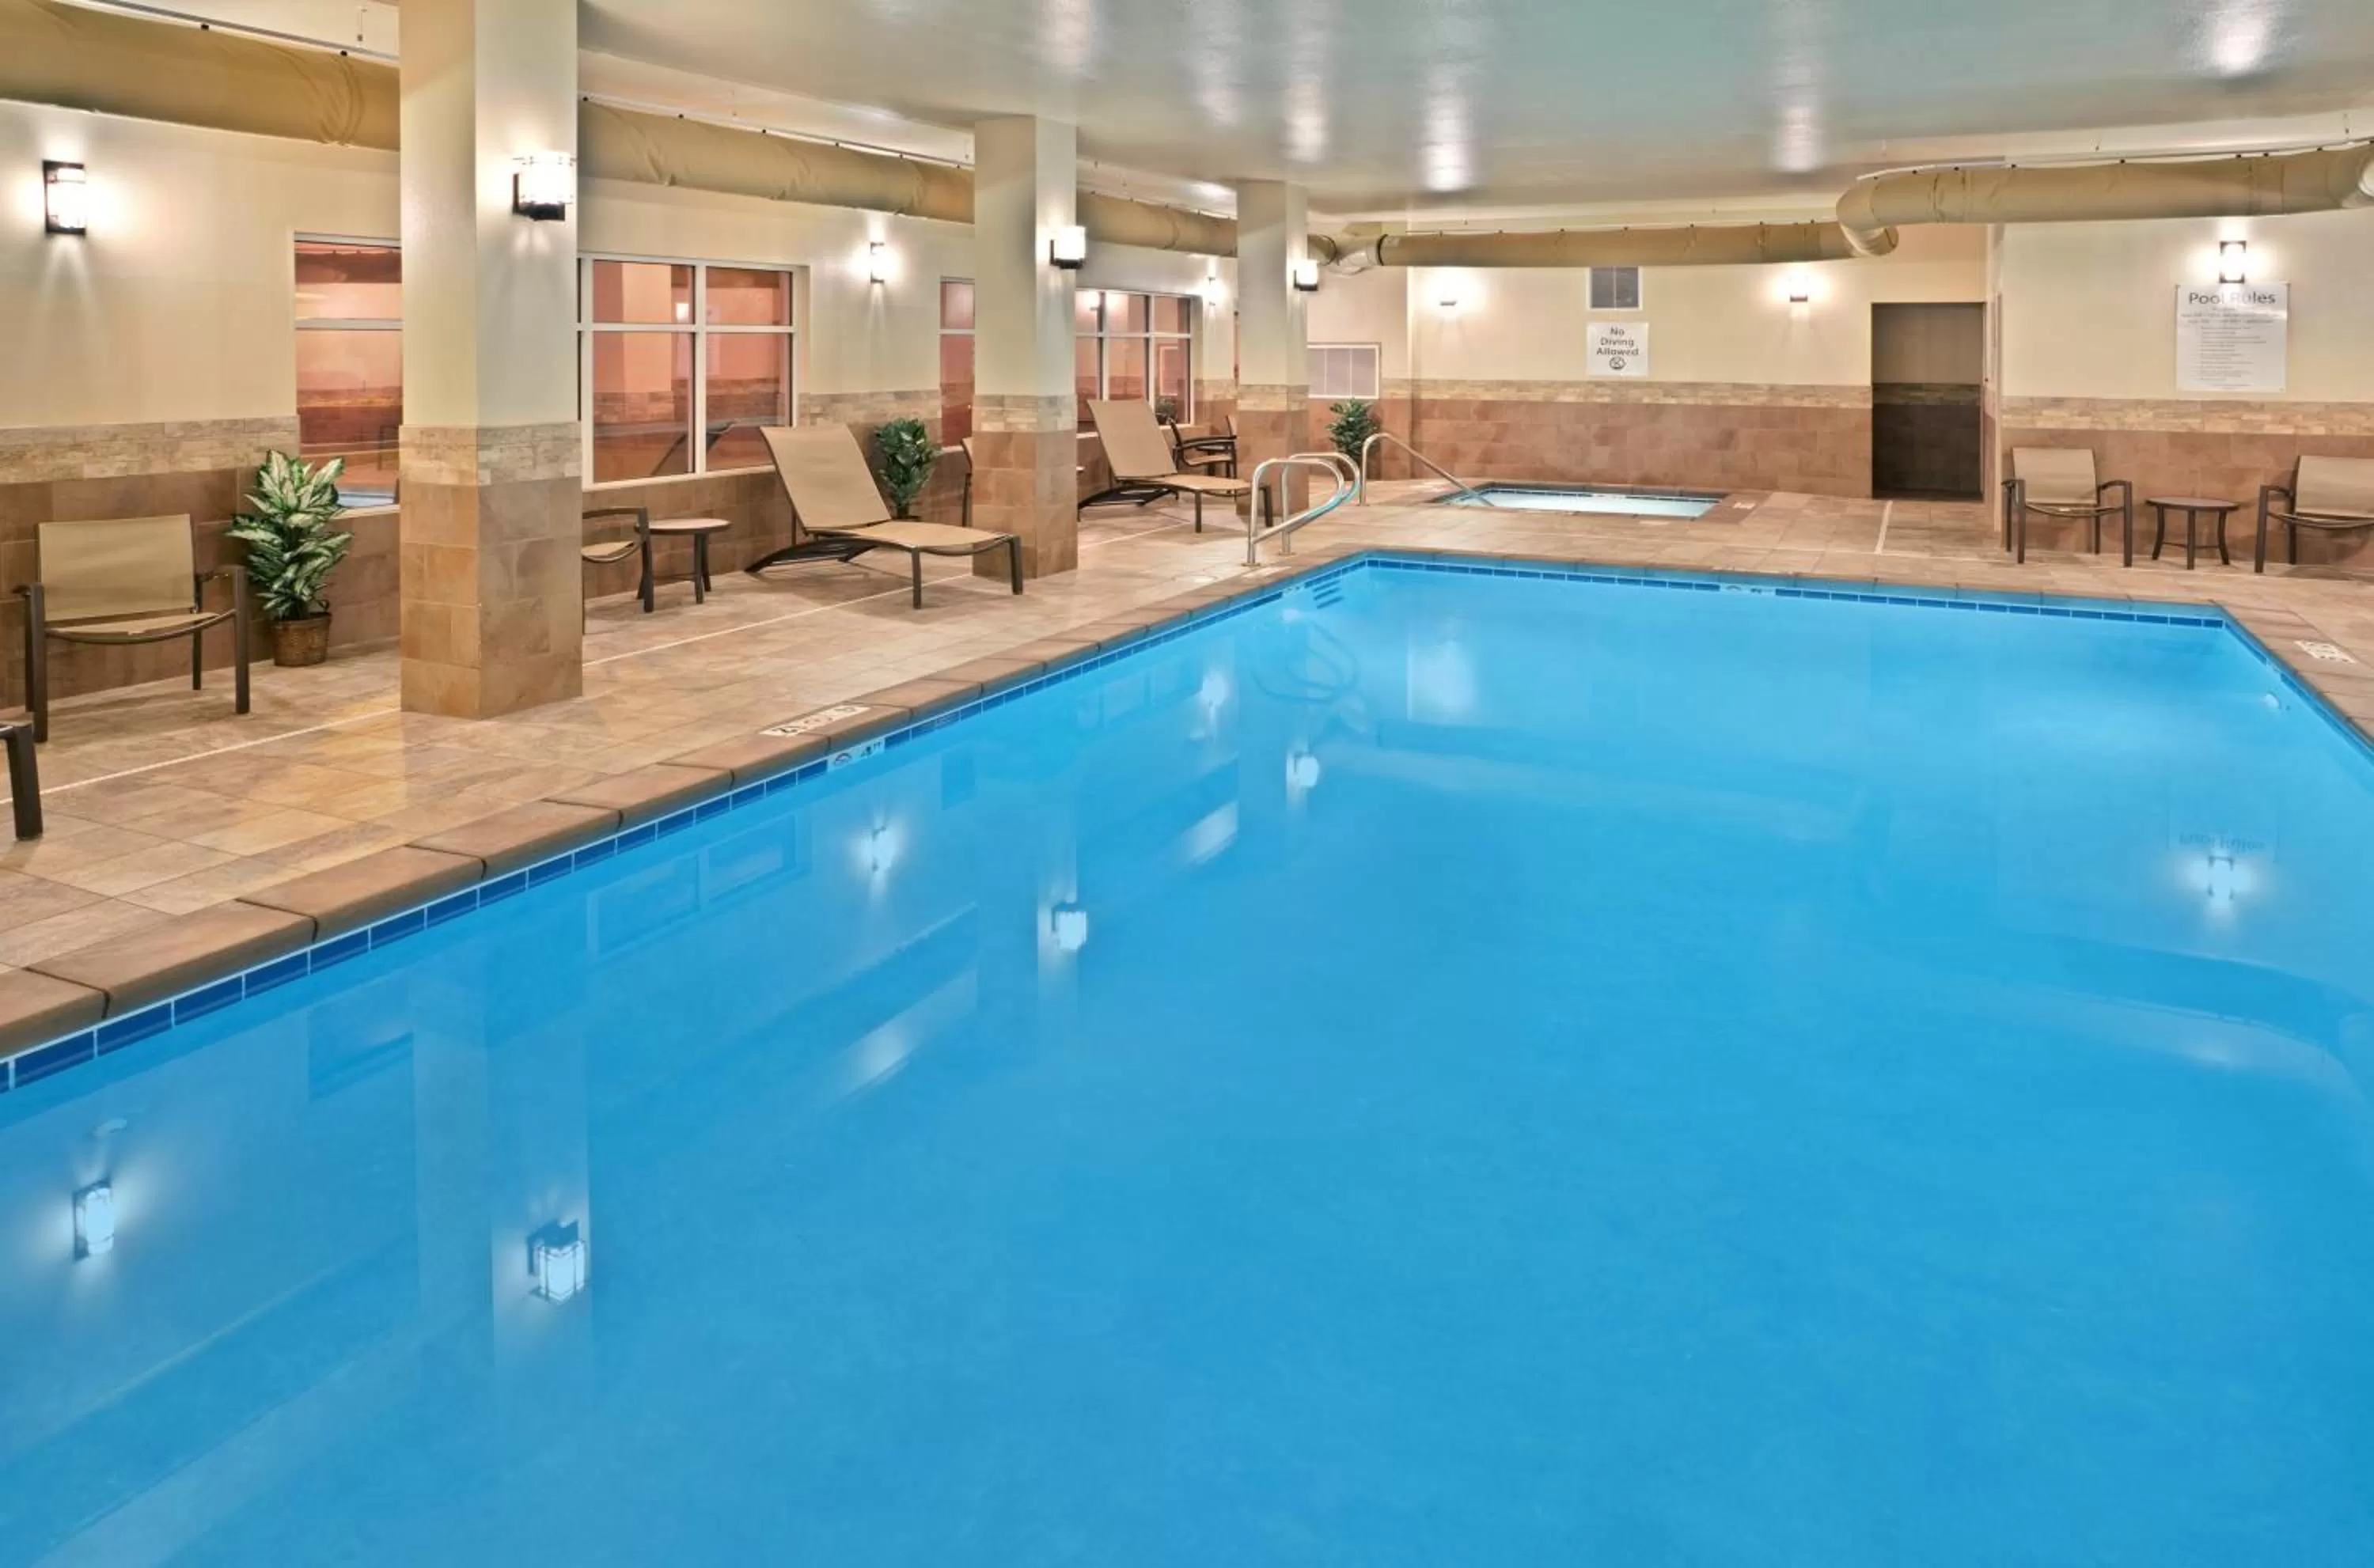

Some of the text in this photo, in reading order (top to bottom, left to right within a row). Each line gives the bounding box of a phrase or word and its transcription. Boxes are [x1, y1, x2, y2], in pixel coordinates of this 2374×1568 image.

[2189, 291, 2277, 304] Pool Rules
[1610, 326, 1625, 336] No
[1600, 337, 1634, 347] Diving
[1596, 347, 1639, 356] Allowed
